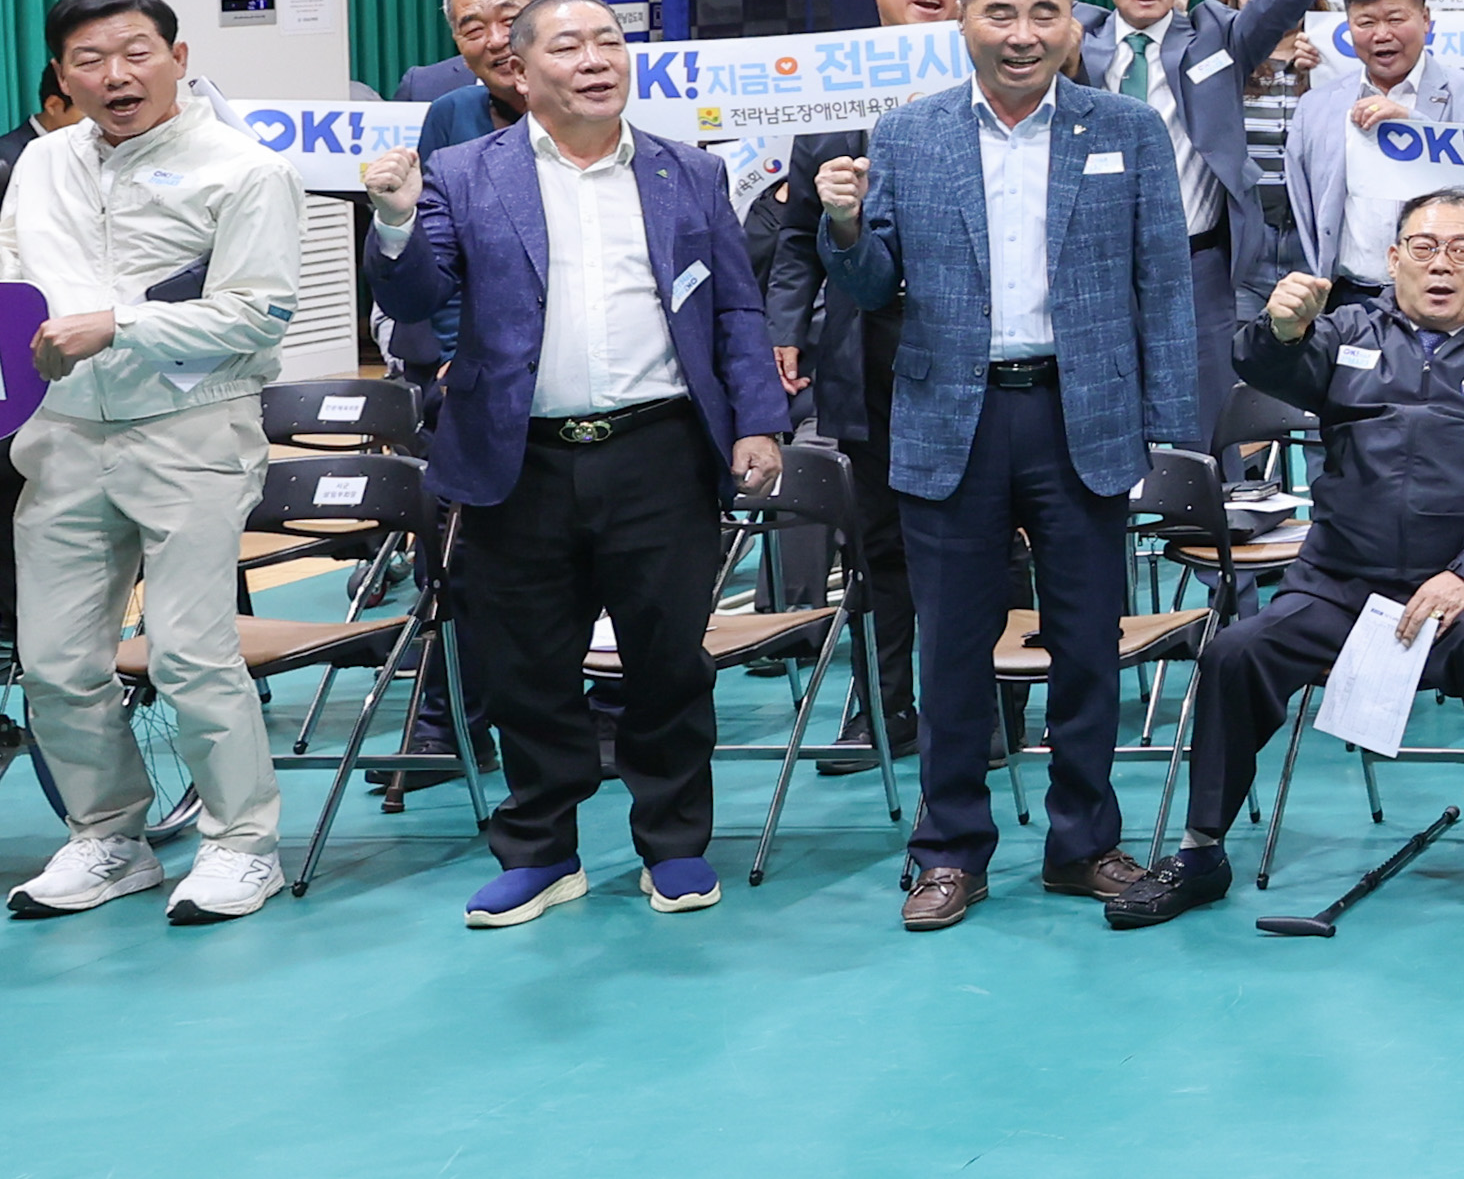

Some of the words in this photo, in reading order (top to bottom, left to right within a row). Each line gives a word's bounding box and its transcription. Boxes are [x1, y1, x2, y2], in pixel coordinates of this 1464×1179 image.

[636, 50, 701, 101] K!
[706, 56, 803, 97] 지금은
[814, 29, 976, 92] 전남시
[243, 108, 365, 155] OK!
[730, 96, 900, 127] 전라남도장애인체육회
